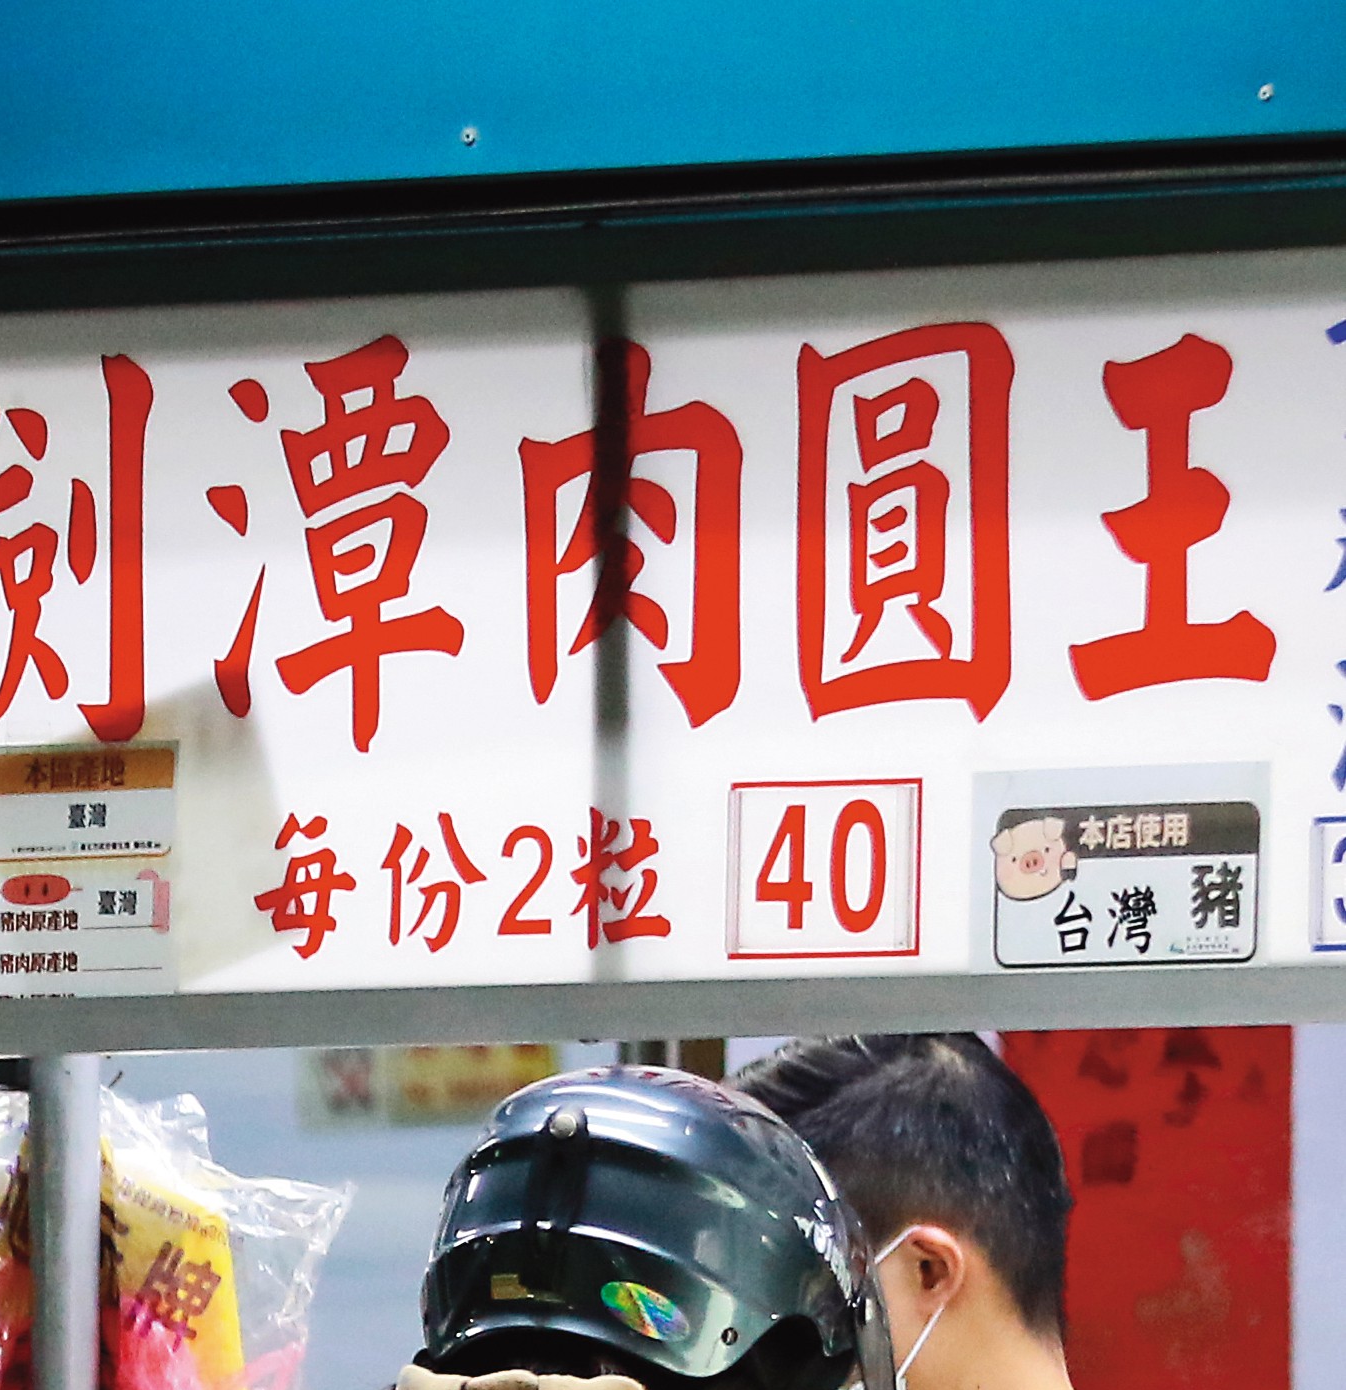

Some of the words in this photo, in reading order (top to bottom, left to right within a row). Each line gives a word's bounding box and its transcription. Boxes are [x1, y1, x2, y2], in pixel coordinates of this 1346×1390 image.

[254, 804, 671, 959] 每份2粒
[755, 799, 886, 933] 40
[1078, 812, 1189, 850] 本店使用
[1054, 886, 1157, 954] 台灣
[1190, 861, 1243, 929] 豬
